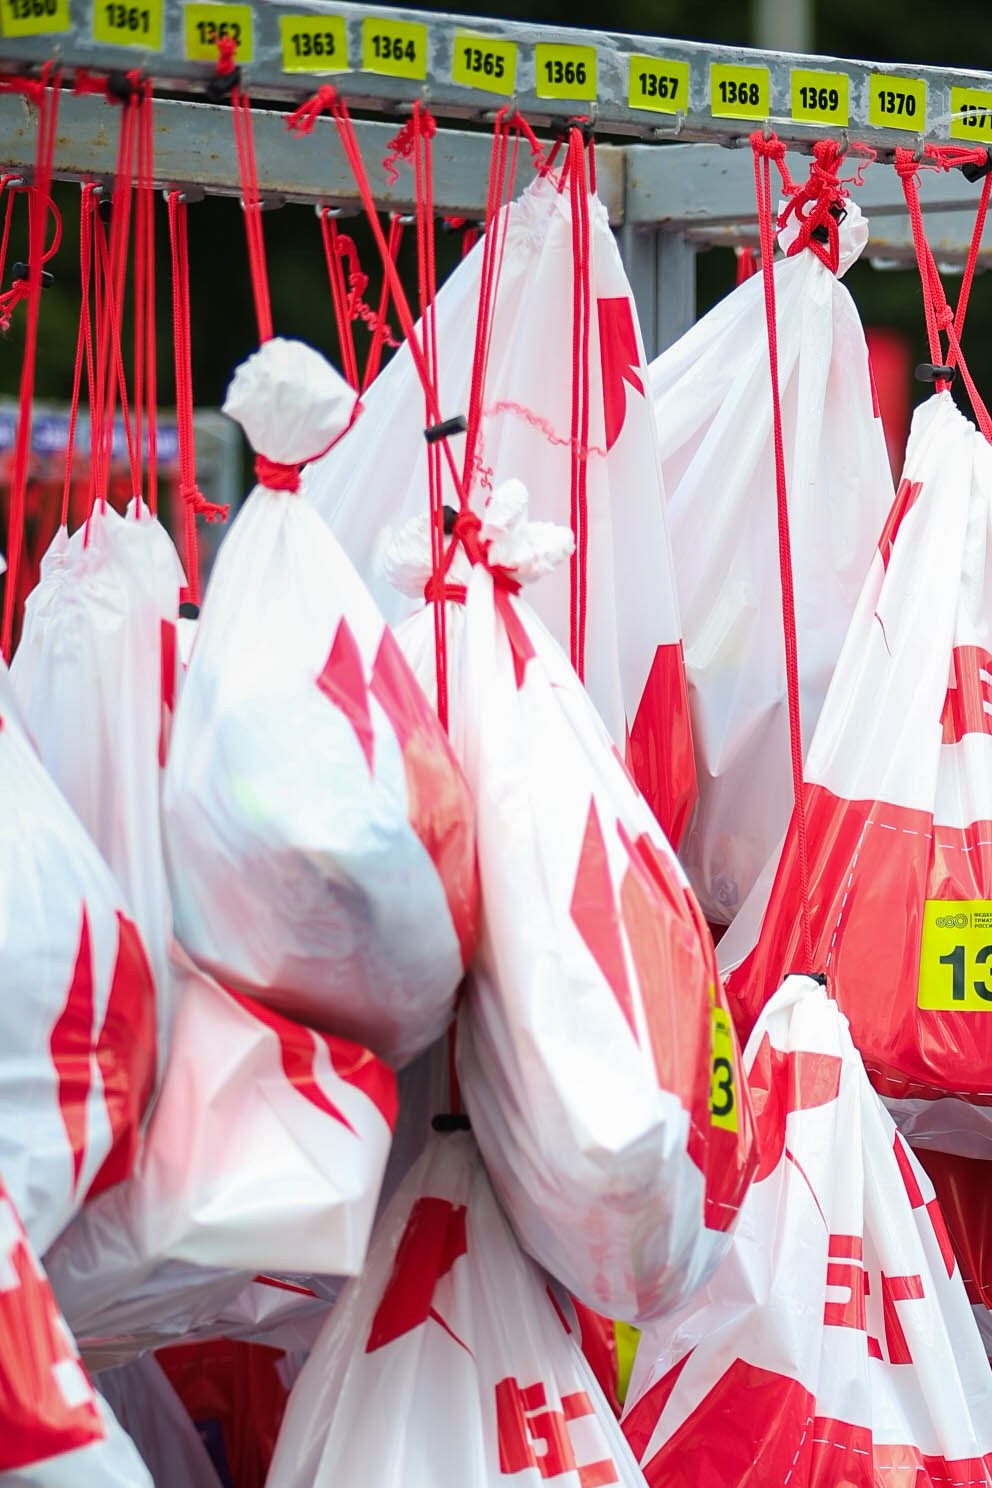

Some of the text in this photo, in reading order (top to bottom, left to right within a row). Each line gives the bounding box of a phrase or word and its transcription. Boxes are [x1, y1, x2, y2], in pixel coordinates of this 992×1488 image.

[105, 3, 150, 33] 1361
[291, 32, 335, 57] 1363
[372, 35, 416, 63] 1364
[463, 48, 504, 78] 1365
[545, 60, 587, 85] 1366
[639, 73, 679, 99] 1367
[719, 81, 760, 106] 1368
[799, 87, 838, 111] 1369
[878, 91, 916, 116] 1370
